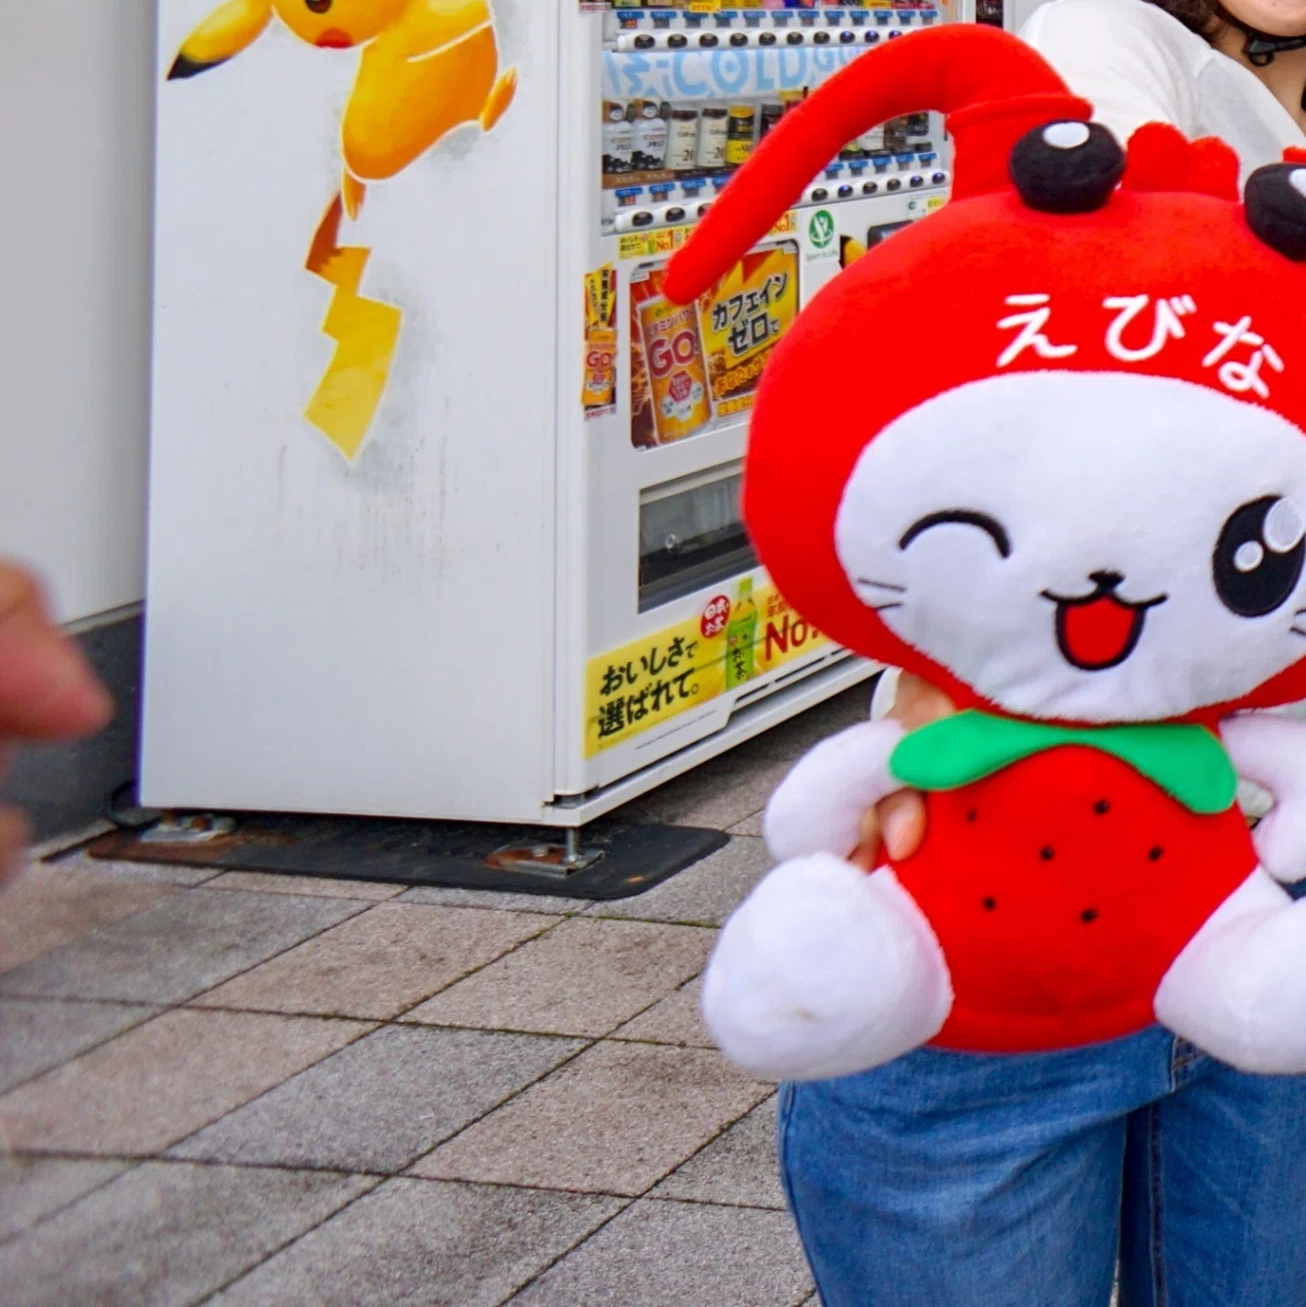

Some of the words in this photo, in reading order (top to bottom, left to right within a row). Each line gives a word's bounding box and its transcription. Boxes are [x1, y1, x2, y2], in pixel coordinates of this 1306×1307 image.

[711, 271, 789, 332] カフェイン
[996, 293, 1286, 399] えびな
[599, 635, 699, 697] おいしさで
[597, 668, 700, 740] 選ばれて。
